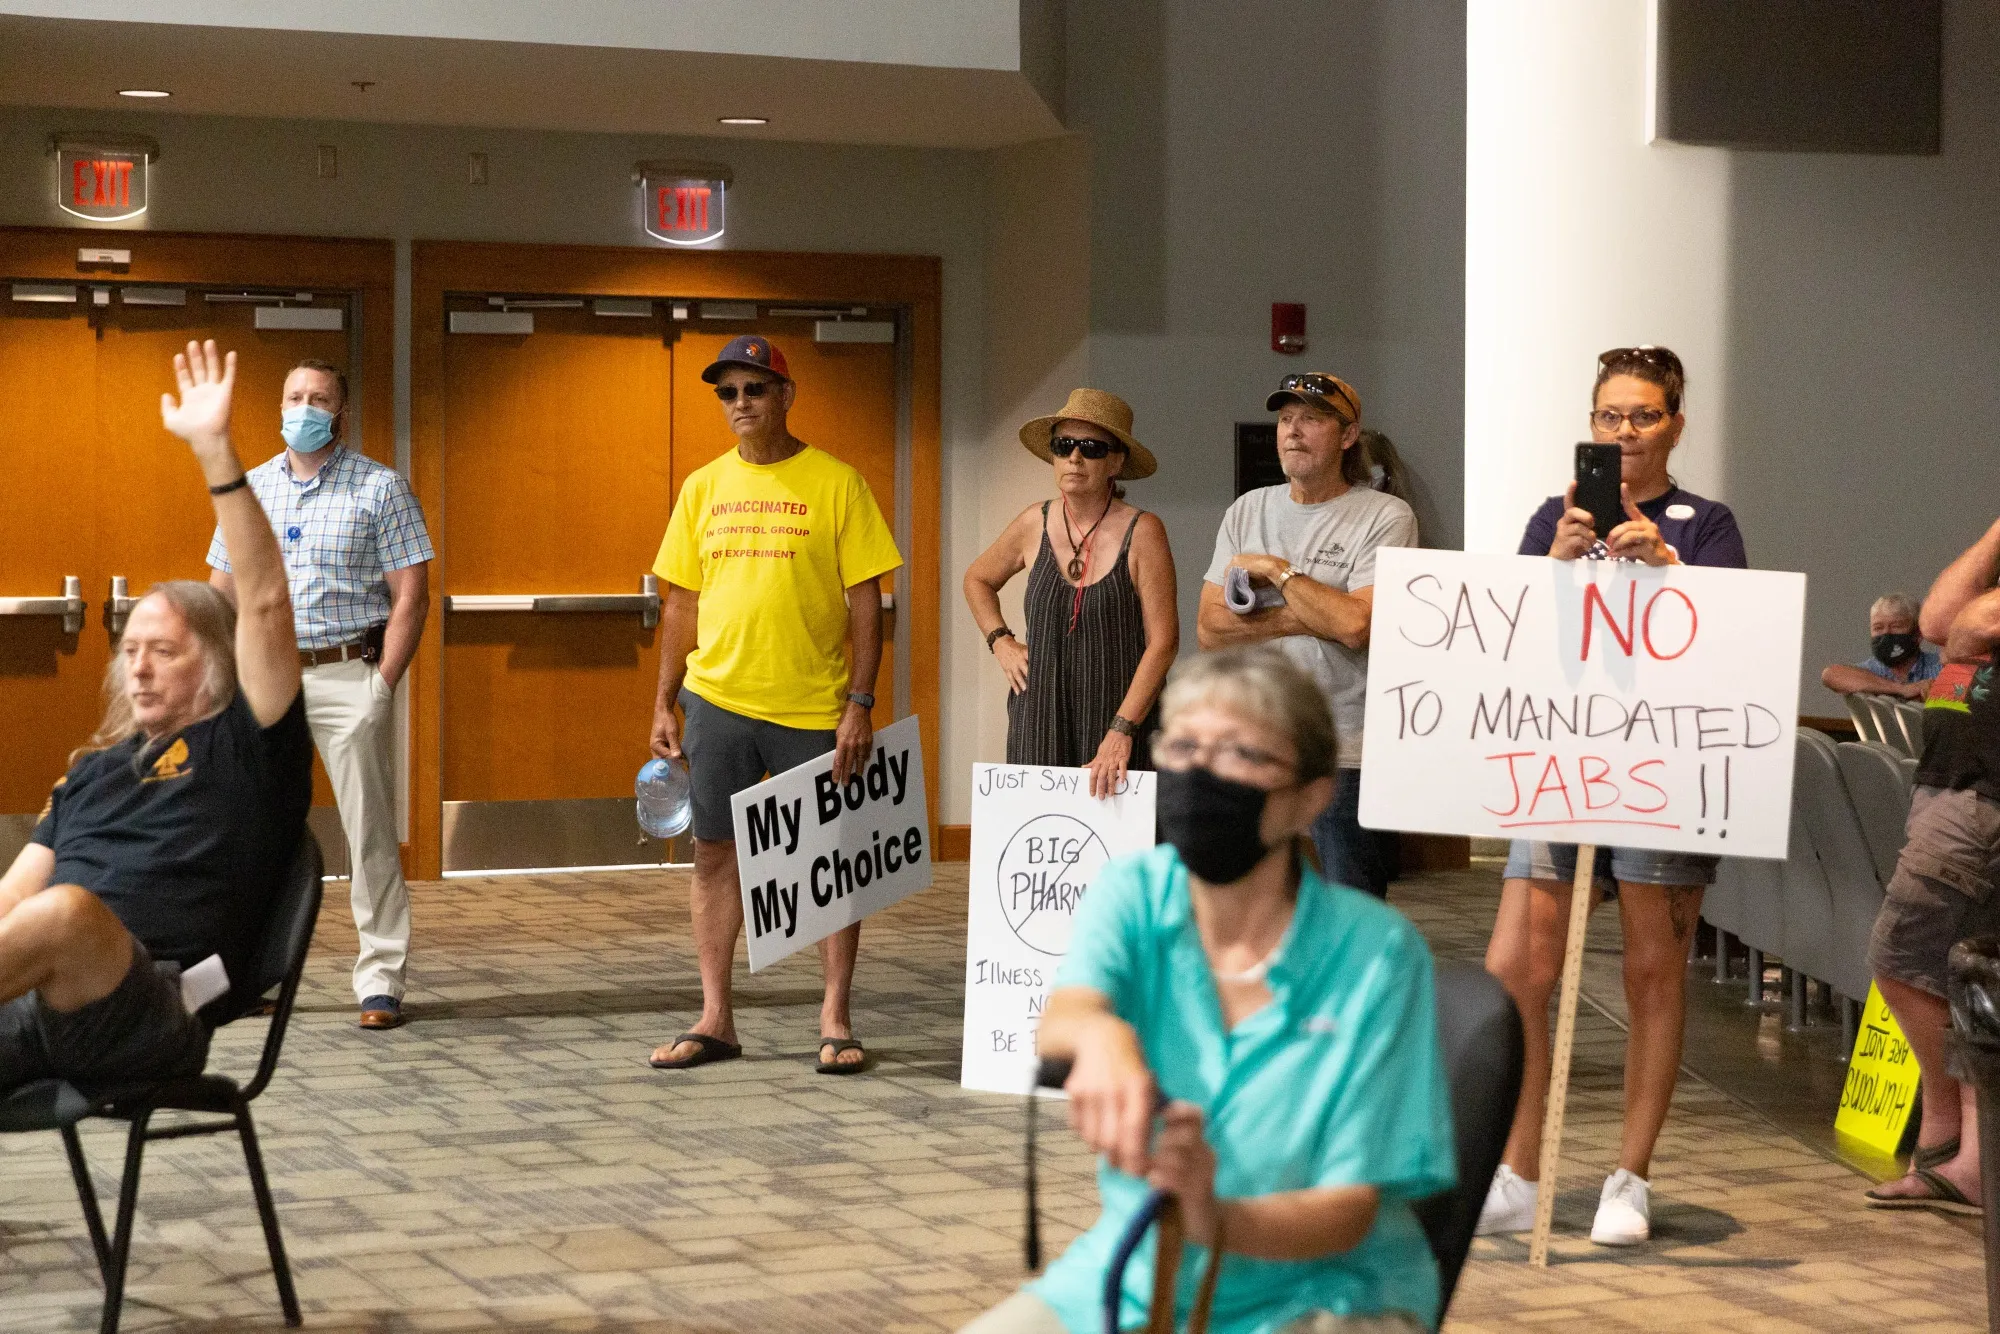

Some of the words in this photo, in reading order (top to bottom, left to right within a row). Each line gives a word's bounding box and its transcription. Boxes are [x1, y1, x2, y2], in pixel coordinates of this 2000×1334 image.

[73, 160, 134, 207] EXIT
[658, 187, 711, 231] EXIT
[711, 500, 808, 516] UNVACCINATED
[706, 529, 715, 538] IN
[717, 526, 767, 535] CONTROL
[770, 526, 810, 537] GROUP
[712, 550, 724, 559] OF
[725, 549, 796, 559] EXPERIMENT
[1398, 574, 1529, 662] SAY
[1580, 579, 1698, 662] NO
[1384, 679, 1443, 740] TO
[1470, 686, 1781, 751] MANDATED
[1040, 769, 1079, 794] SAY
[746, 794, 802, 856] My
[814, 746, 909, 826] Body
[1026, 837, 1080, 864] BIG
[751, 878, 799, 938] My
[811, 826, 922, 908] Choice
[991, 1029, 1018, 1052] BE
[1859, 1026, 1888, 1061] NOT
[1888, 1038, 1910, 1065] ARE
